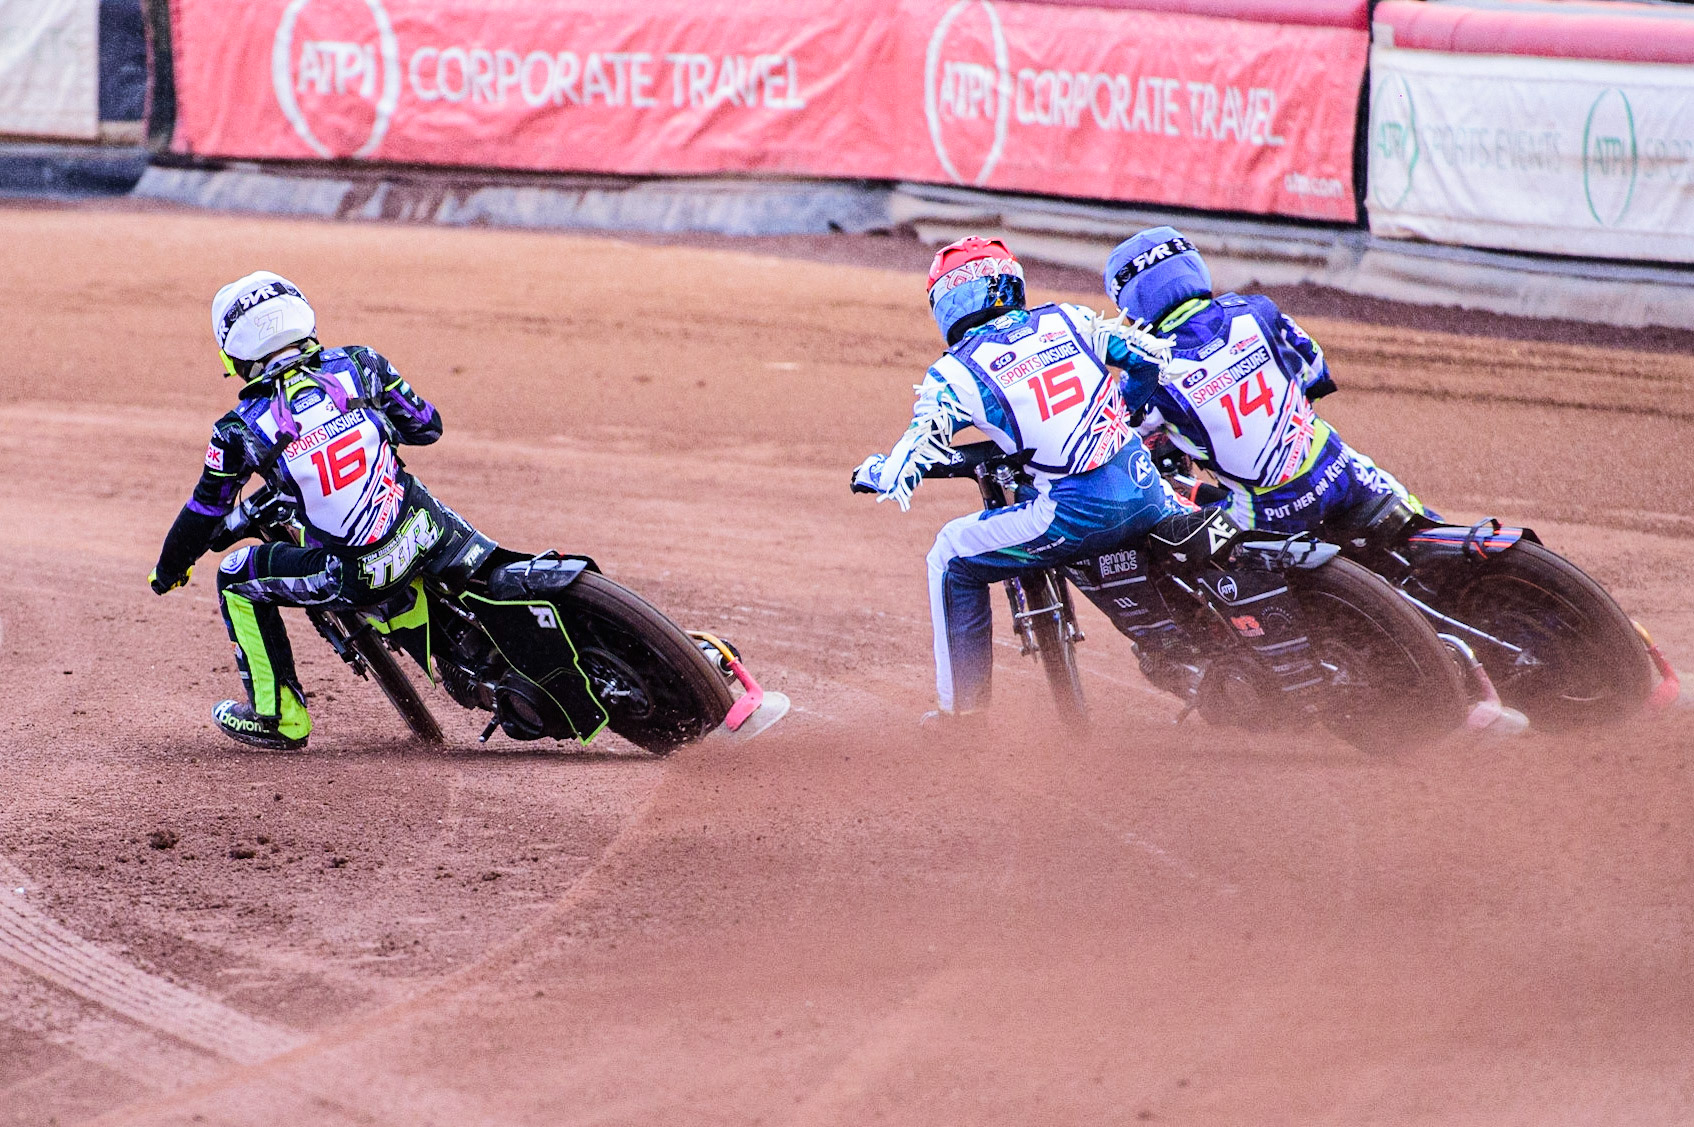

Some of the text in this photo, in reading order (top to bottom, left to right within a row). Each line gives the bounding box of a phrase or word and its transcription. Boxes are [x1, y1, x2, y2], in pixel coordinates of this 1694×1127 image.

[408, 46, 656, 108] CORPORATE
[664, 51, 806, 110] TRAVEL
[1016, 67, 1181, 136] CORPORATE
[1187, 80, 1285, 146] TRAVEL
[995, 353, 1012, 369] SCB
[1187, 371, 1204, 386] SCB
[1027, 361, 1085, 422] 15
[1220, 370, 1274, 439] 14
[311, 429, 367, 497] 16
[1264, 505, 1291, 521] PUT
[1293, 492, 1316, 512] HER
[1315, 481, 1329, 496] ON
[1099, 549, 1137, 572] pennine
[1103, 560, 1138, 576] BLINDS
